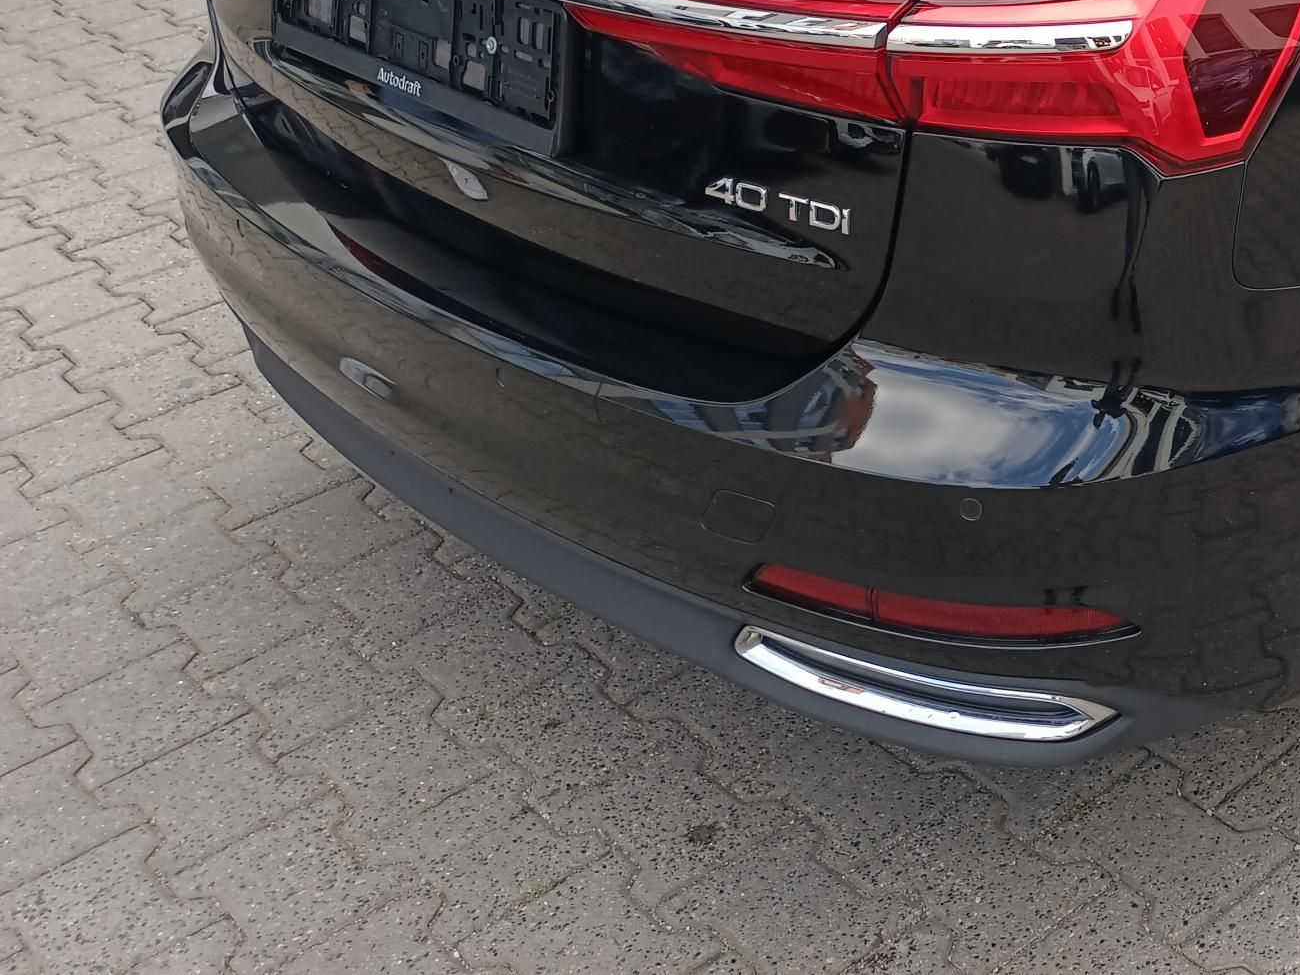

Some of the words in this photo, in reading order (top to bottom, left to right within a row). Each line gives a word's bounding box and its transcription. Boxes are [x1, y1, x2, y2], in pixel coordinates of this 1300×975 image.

[377, 67, 422, 97] Autodraft
[704, 177, 768, 212] 40
[778, 192, 851, 235] TDI
